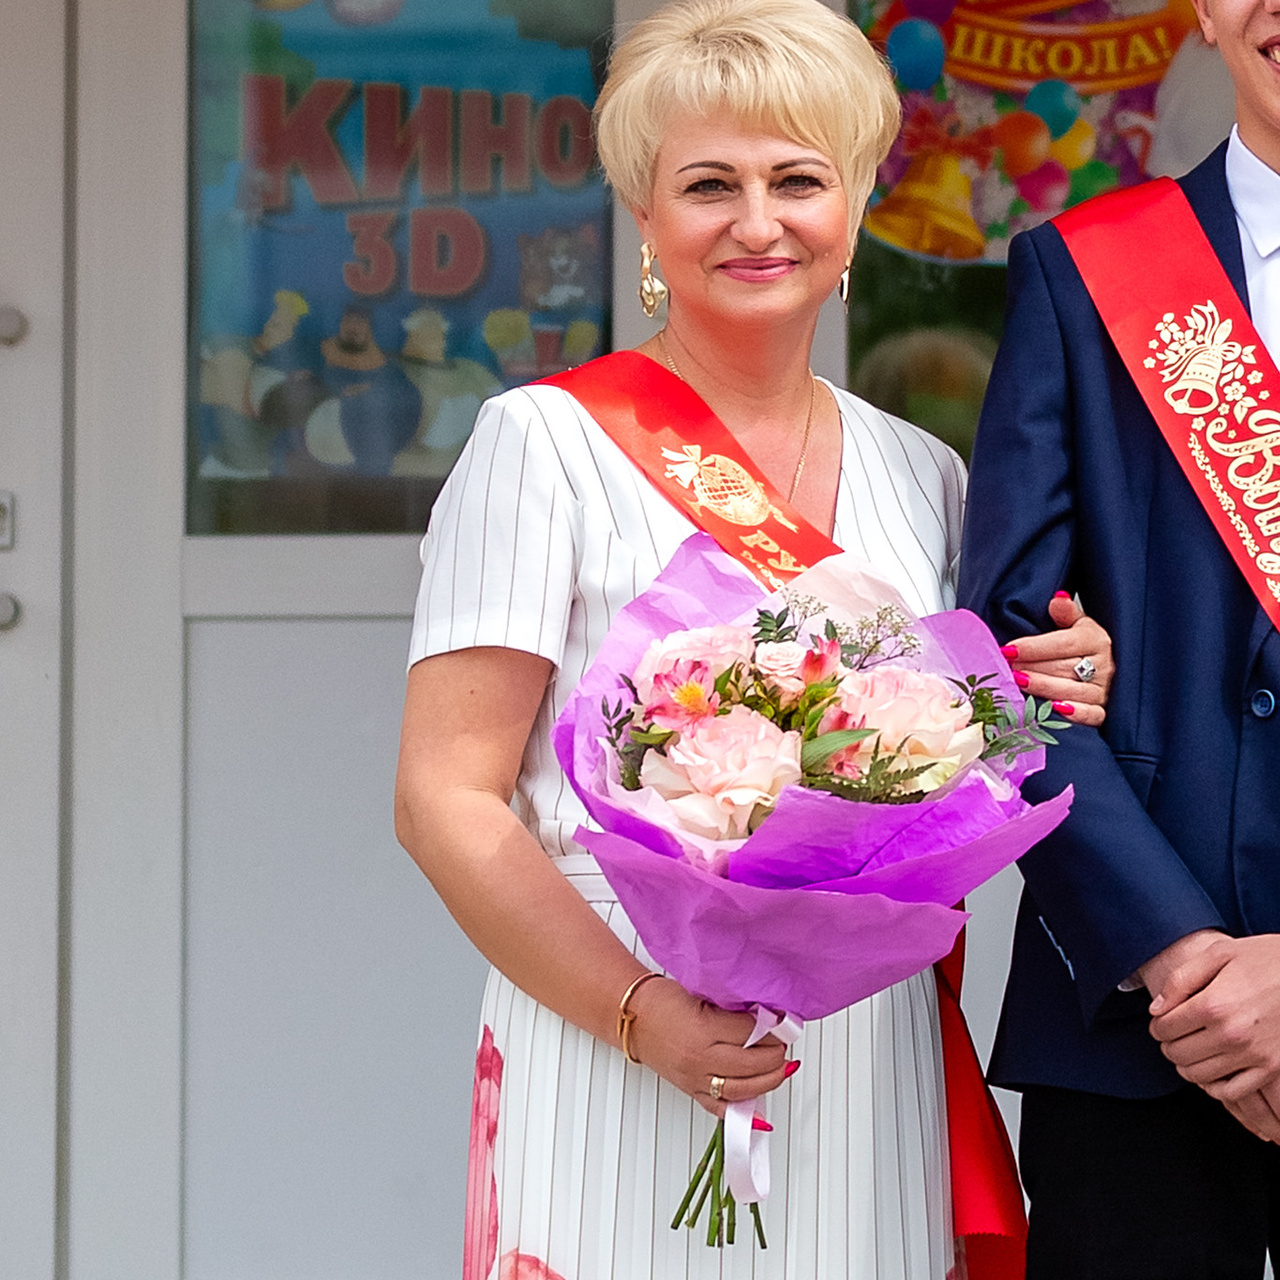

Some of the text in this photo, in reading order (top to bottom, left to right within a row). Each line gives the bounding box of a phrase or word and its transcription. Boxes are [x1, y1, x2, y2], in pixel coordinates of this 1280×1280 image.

[951, 24, 1173, 76] ШКОЛА!
[243, 74, 594, 208] КИНО
[343, 207, 487, 297] 3D
